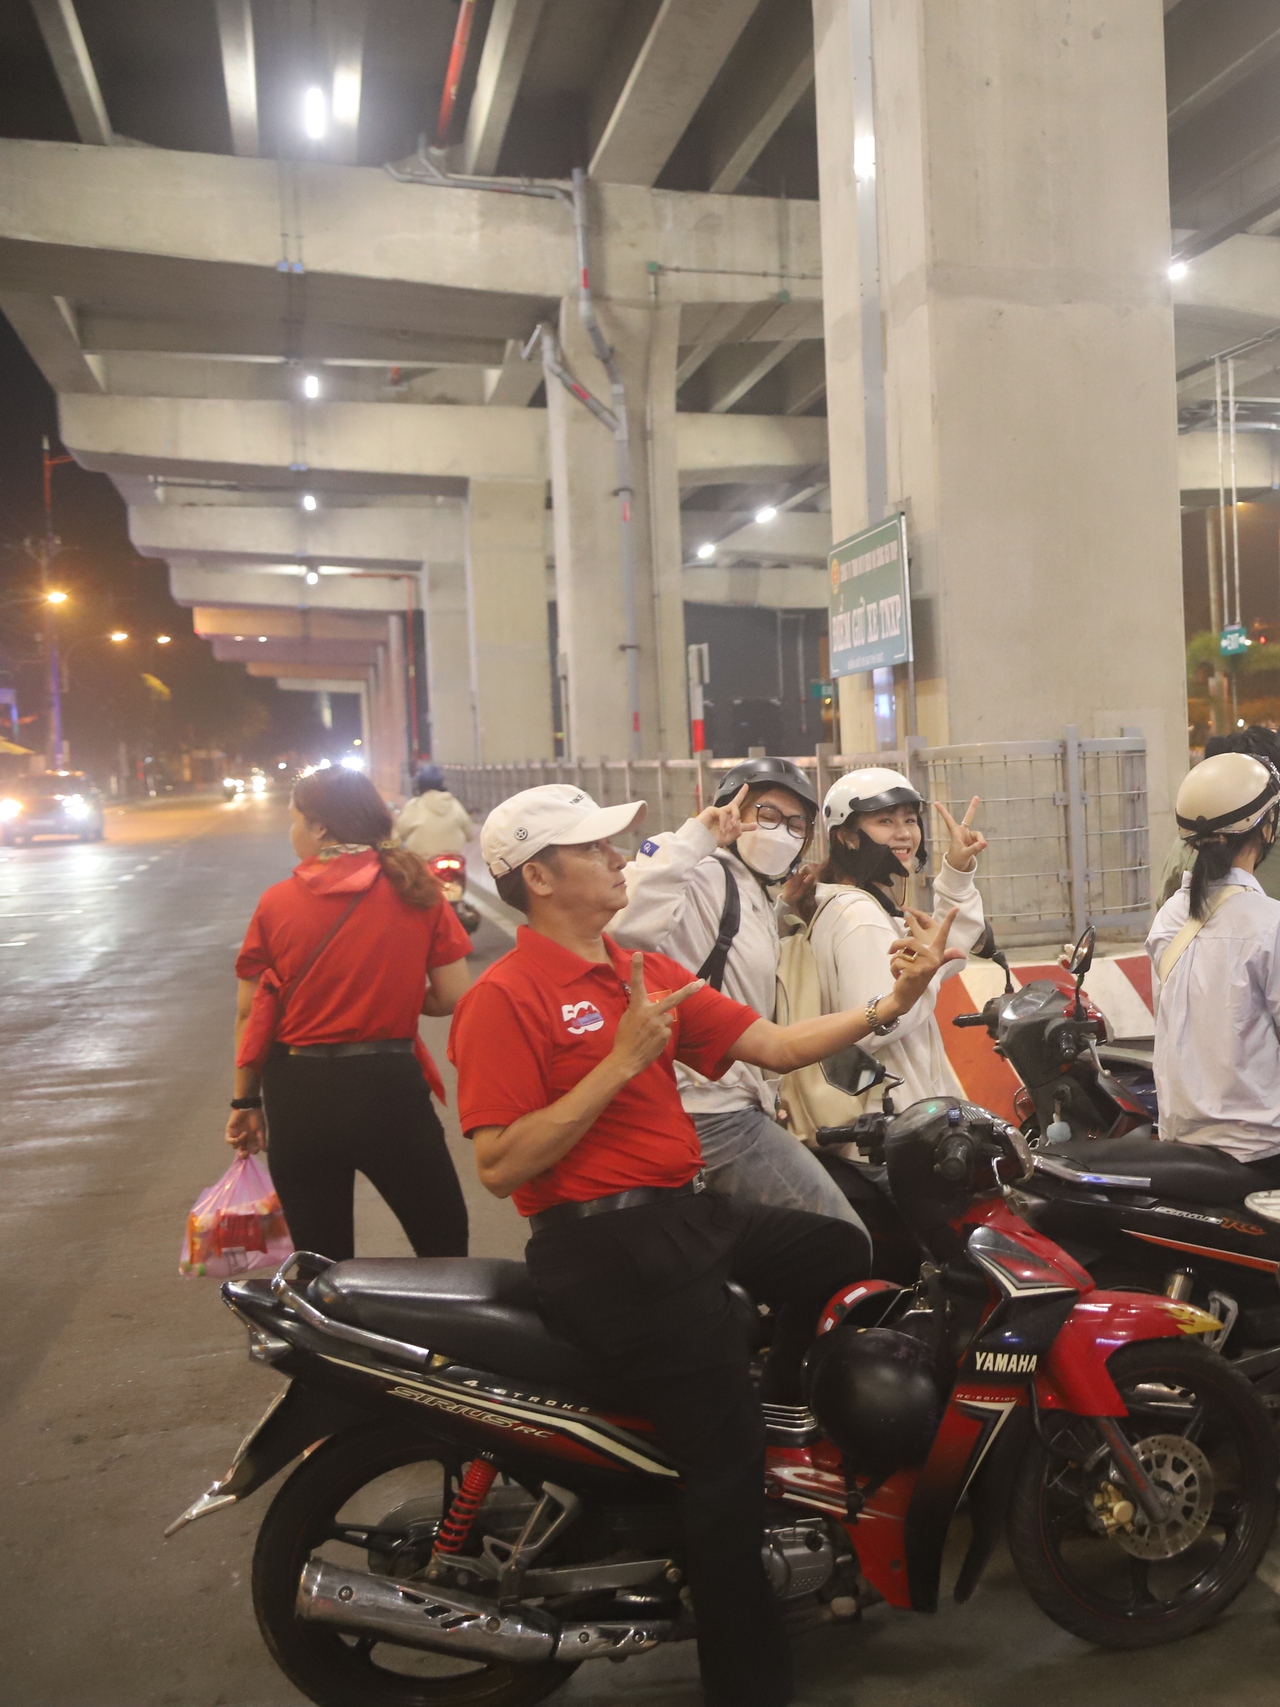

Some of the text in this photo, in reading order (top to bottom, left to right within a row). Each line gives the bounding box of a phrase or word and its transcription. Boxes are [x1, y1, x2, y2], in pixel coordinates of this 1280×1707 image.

[866, 602, 879, 643] XE
[569, 793, 584, 805] NIKE
[975, 1351, 1038, 1373] YAMAHA
[386, 1386, 555, 1439] SIRIUS RC
